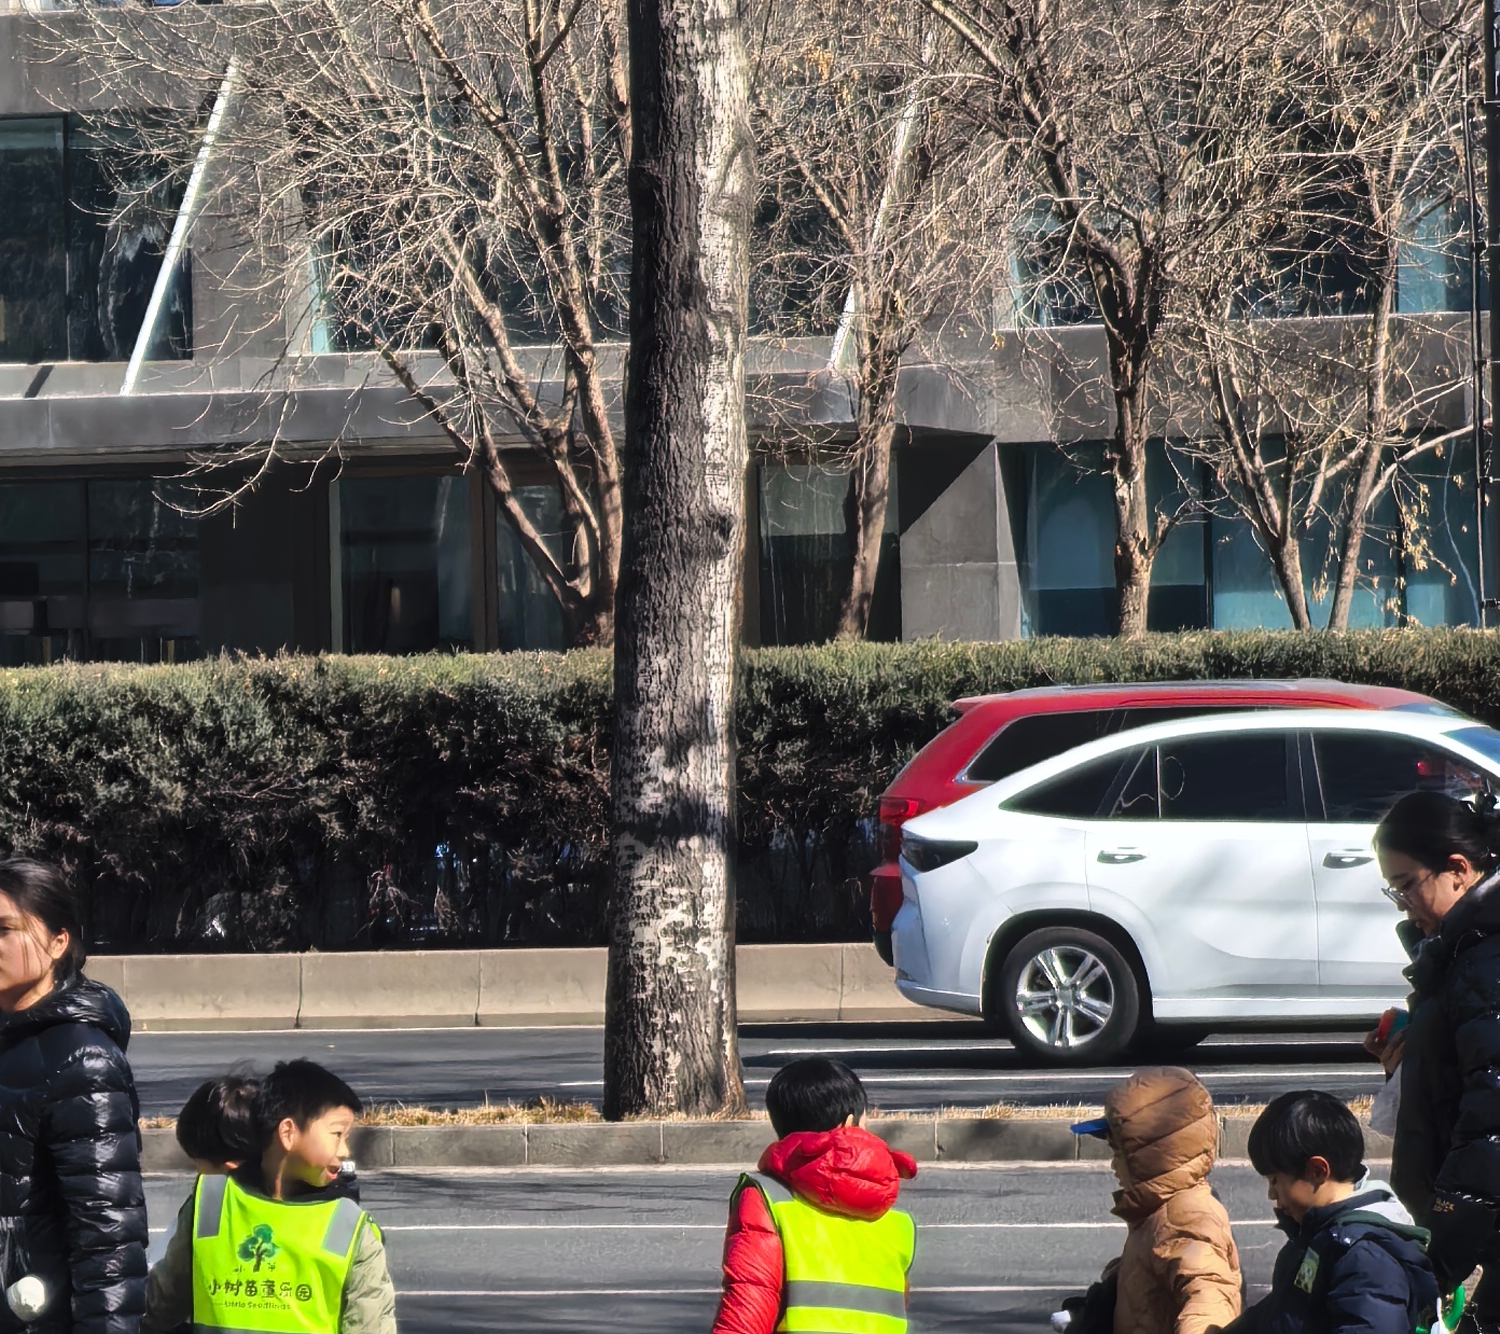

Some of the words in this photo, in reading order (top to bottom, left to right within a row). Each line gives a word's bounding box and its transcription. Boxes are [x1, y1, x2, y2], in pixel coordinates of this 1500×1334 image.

[208, 1278, 312, 1302] 小树苗童乐园
